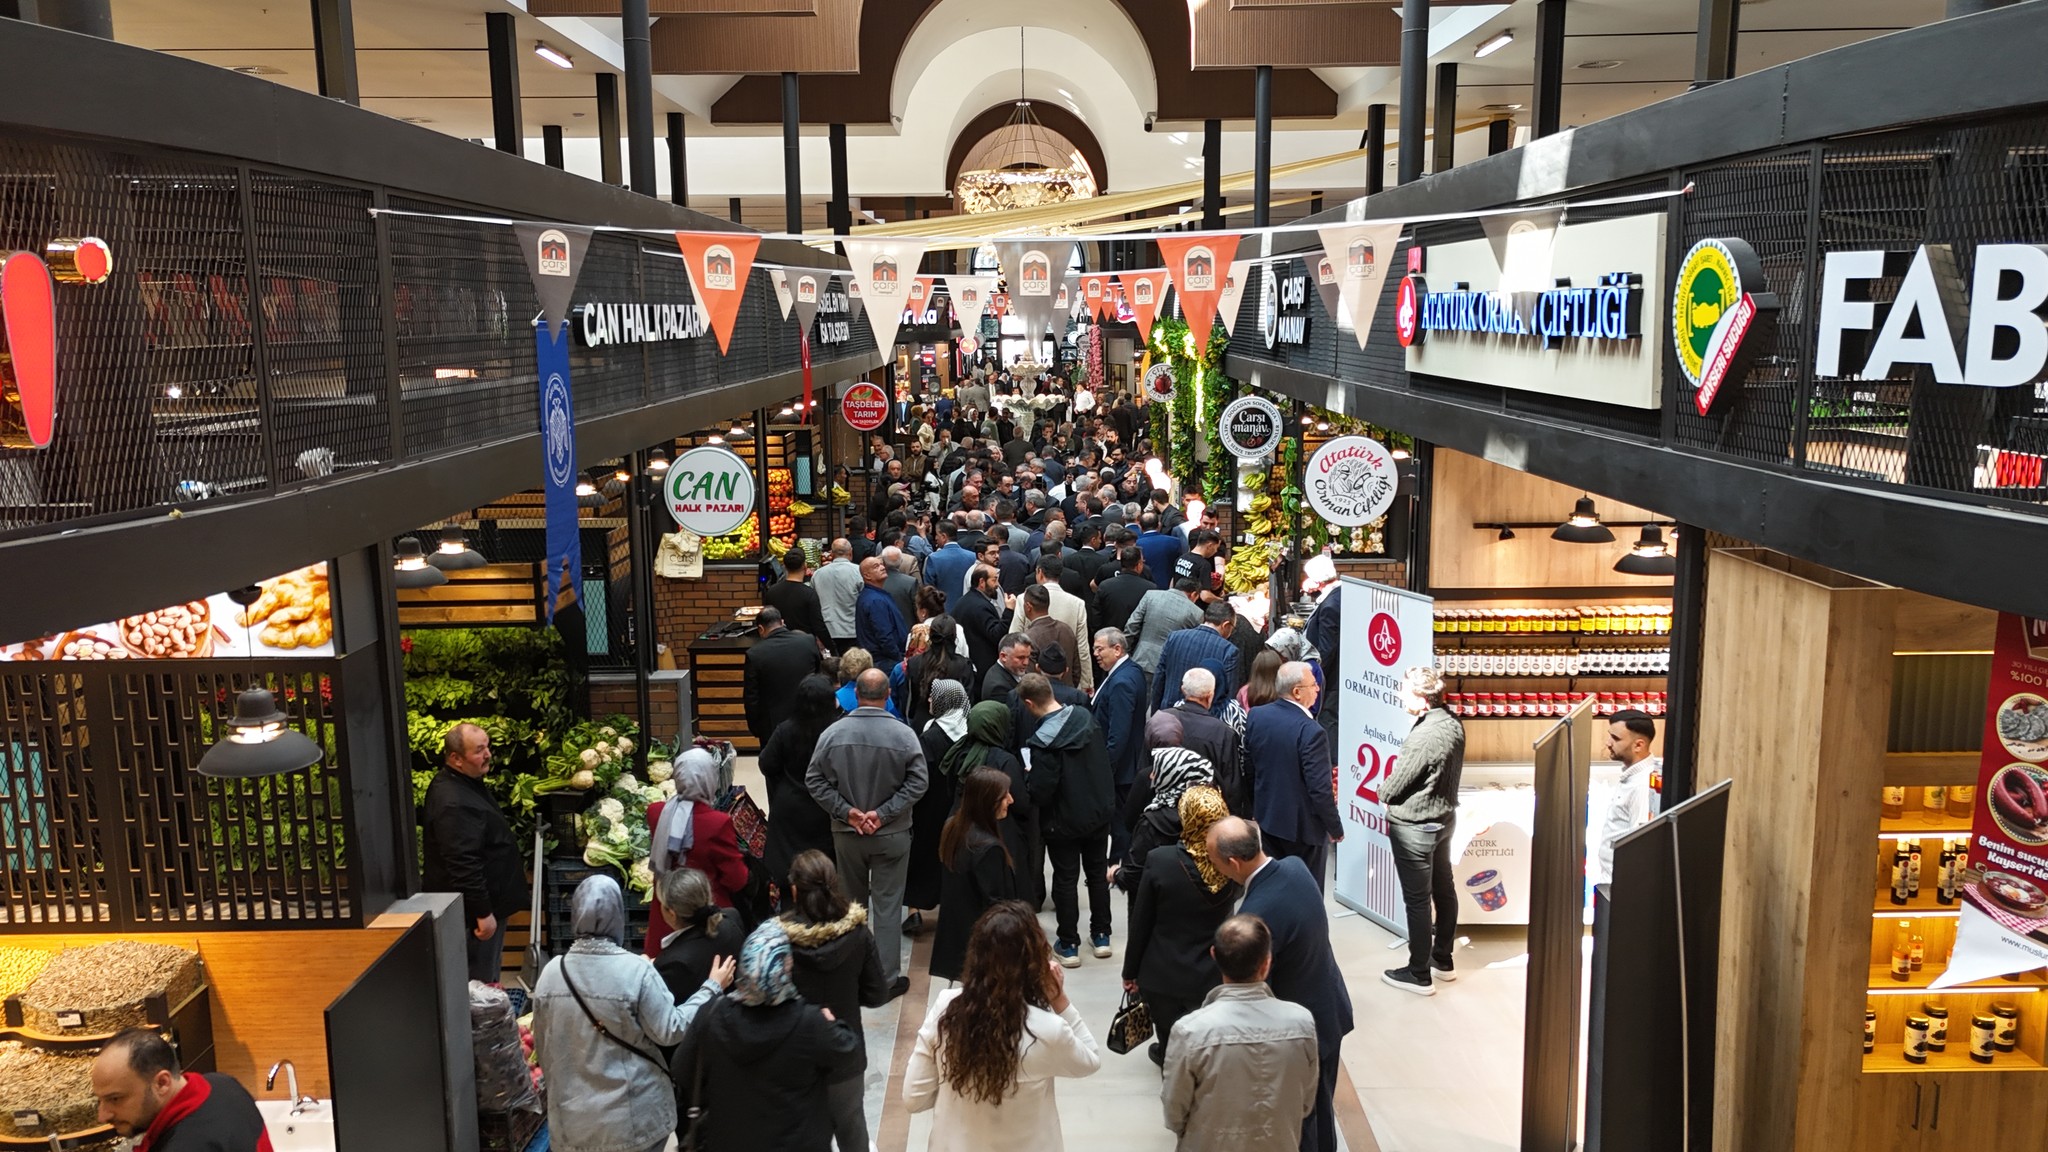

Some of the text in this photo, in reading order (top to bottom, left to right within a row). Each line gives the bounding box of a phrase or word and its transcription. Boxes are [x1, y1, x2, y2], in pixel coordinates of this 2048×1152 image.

[541, 260, 567, 271] çarşı
[707, 274, 733, 285] çarşı
[873, 282, 898, 291] çarşı
[1022, 282, 1048, 291] çarşı
[1187, 276, 1213, 286] çarşı
[1281, 276, 1306, 311] ÇARŞI
[1421, 281, 1477, 331] ATATÜRK
[1539, 272, 1629, 350] ÇİFTLİĞİ
[583, 302, 620, 347] CAN
[622, 303, 663, 343] HALK
[1278, 316, 1306, 345] MANAV
[1698, 299, 1752, 408] KAYSERİ SUCUĞU
[845, 400, 885, 409] TAŞDELEN
[853, 410, 878, 418] TARIM
[1238, 410, 1266, 425] Çarşı
[672, 470, 742, 501] CAN
[1314, 474, 1393, 518] Orman Çiftliği
[675, 504, 745, 513] HALK PAZARI
[2009, 670, 2043, 686] %100
[1344, 678, 1407, 709] ORMAN ÇİFT
[1475, 847, 1514, 858] ÇİFTLİĞİ
[1978, 835, 2015, 857] Benim
